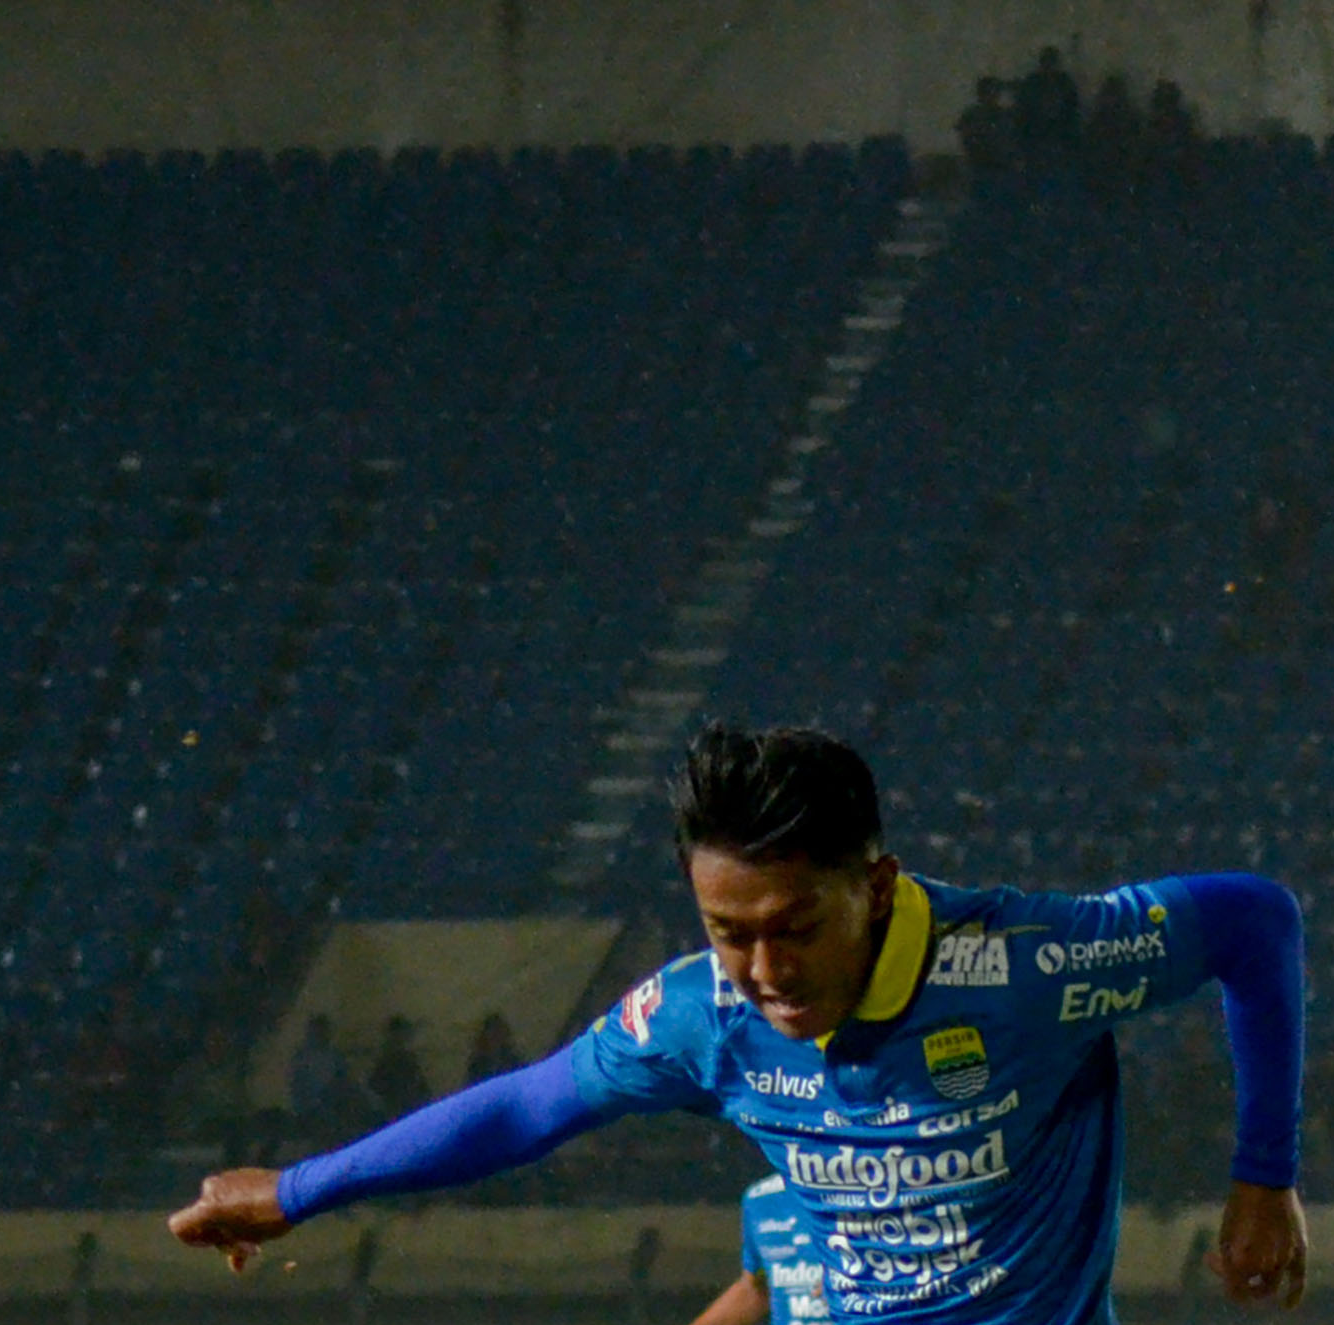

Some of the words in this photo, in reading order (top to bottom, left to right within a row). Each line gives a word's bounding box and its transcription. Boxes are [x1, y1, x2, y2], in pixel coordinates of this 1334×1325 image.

[932, 933, 1010, 972] PRIA
[744, 1066, 817, 1100] salvus
[783, 1129, 1007, 1208] Indofood
[835, 1204, 969, 1246] Mobil
